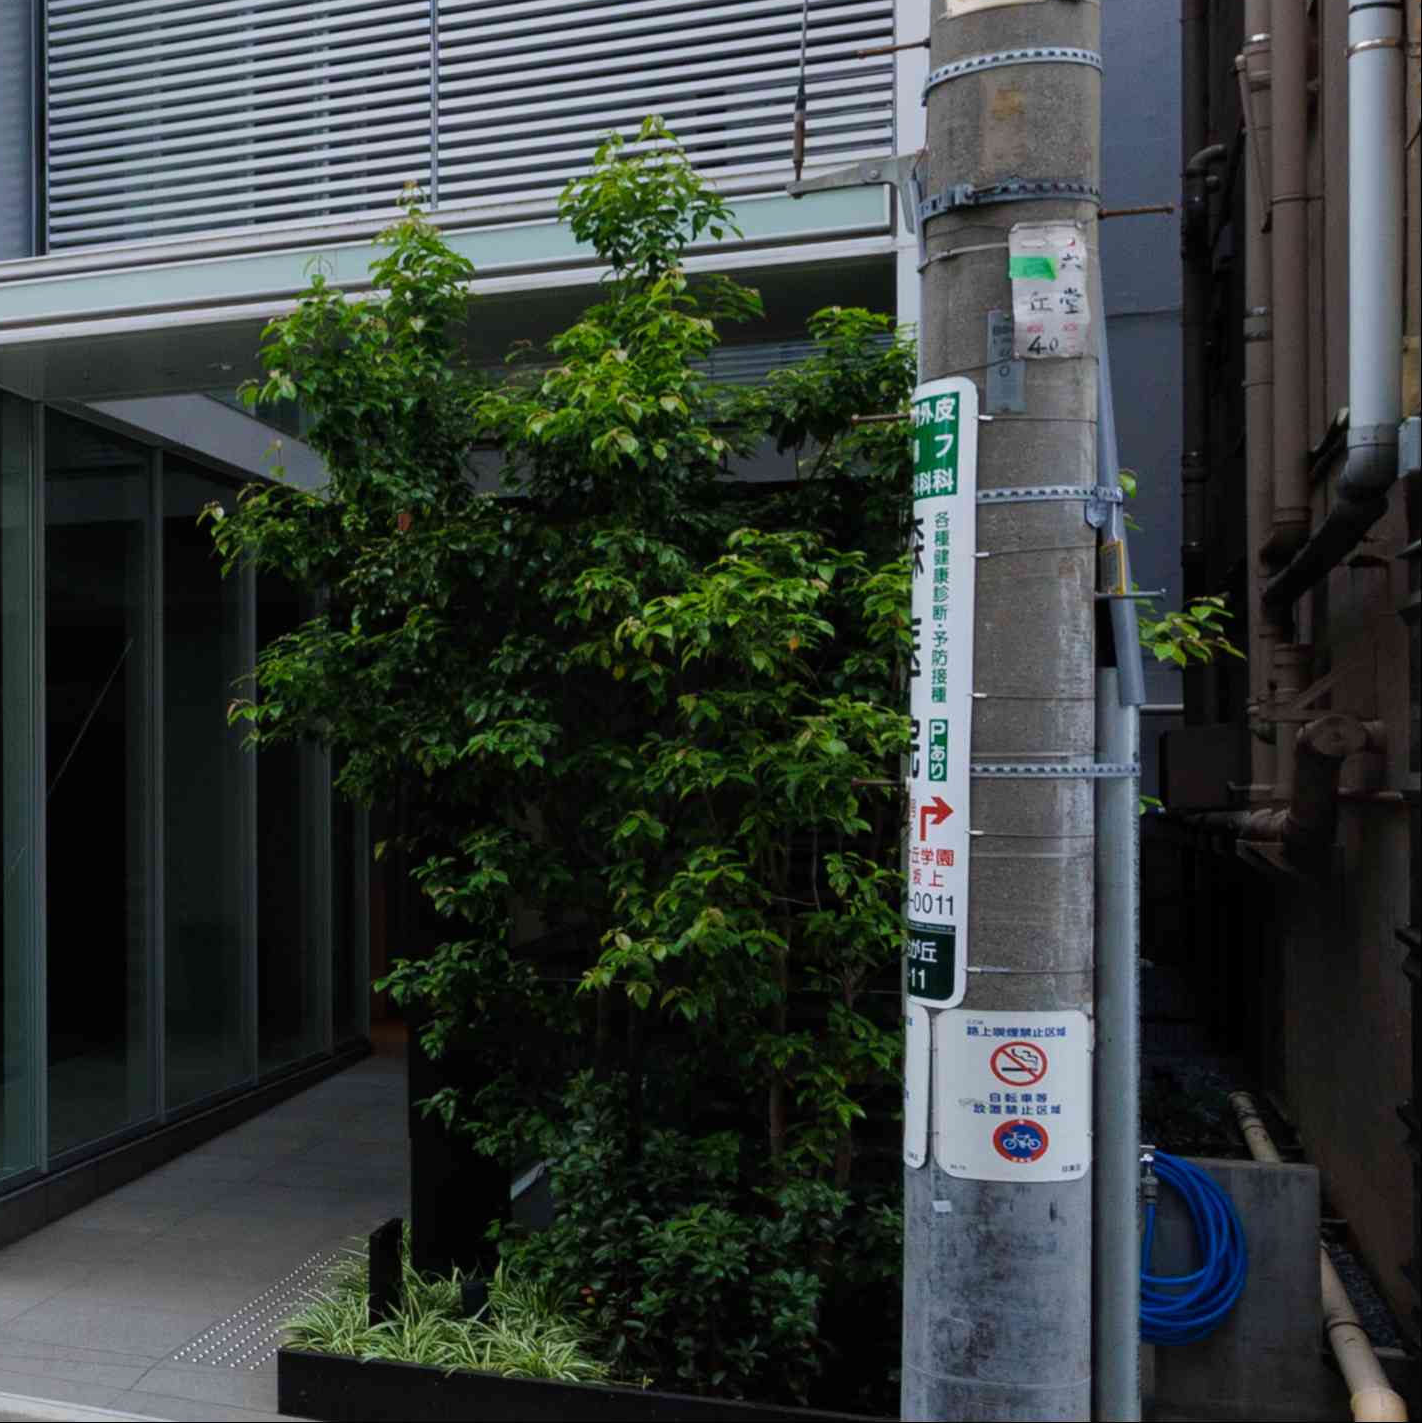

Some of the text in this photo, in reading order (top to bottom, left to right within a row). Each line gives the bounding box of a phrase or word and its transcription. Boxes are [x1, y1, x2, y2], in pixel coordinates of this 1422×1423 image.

[934, 396, 955, 492] 皮フ科
[930, 512, 951, 704] 各種健康診断・予防接種
[929, 721, 946, 781] Pあり
